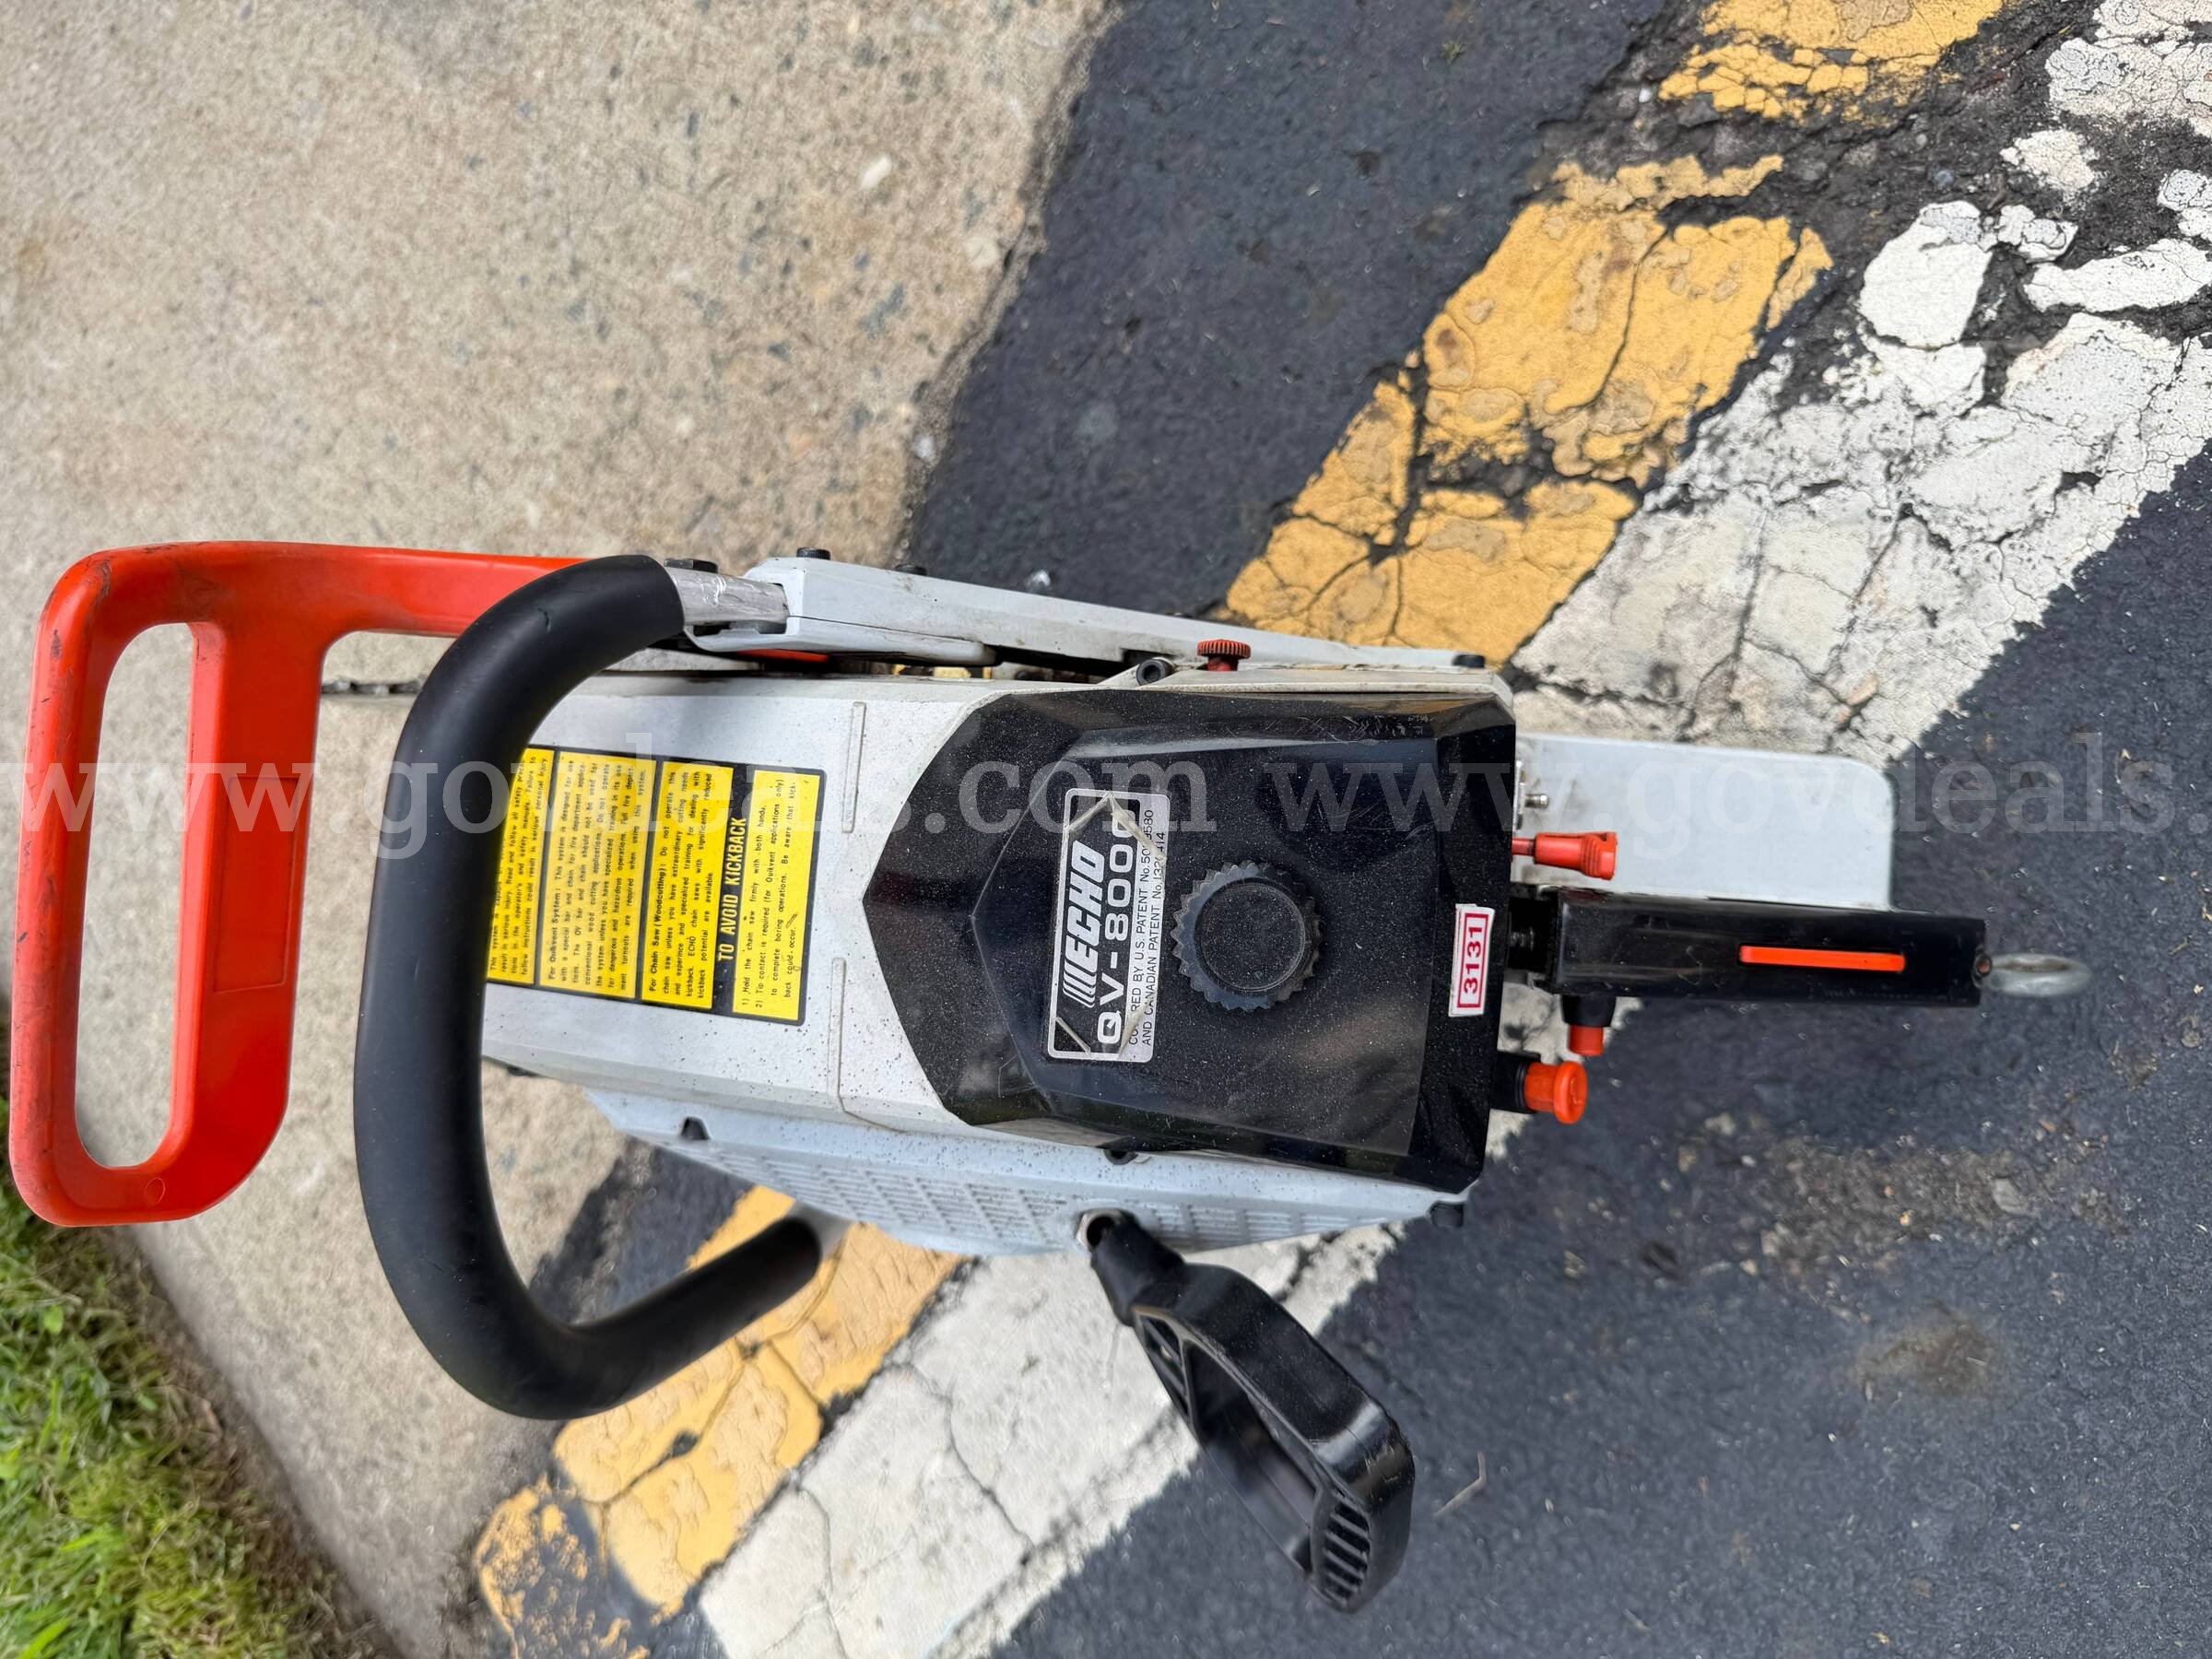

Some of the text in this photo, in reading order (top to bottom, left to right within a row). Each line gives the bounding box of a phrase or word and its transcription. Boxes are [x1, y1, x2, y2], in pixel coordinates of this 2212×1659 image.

[679, 771, 688, 791] needs
[701, 773, 712, 799] reduced
[773, 779, 784, 796] only)
[787, 782, 795, 798] kick-
[664, 792, 676, 818] operate
[676, 798, 687, 822] cutting
[688, 794, 700, 818] dealing
[697, 808, 710, 850] significantly
[769, 803, 782, 844] applications
[754, 834, 762, 851] both
[783, 826, 792, 848] aware
[670, 830, 684, 877] extraordinary
[683, 842, 694, 869] training
[765, 851, 777, 882] Quikvent
[679, 877, 691, 915] specialized
[703, 871, 713, 902] available.
[718, 817, 745, 962] TO AVOID KICKBACK
[749, 882, 759, 902] firmly
[776, 872, 789, 912] operations.
[689, 909, 698, 927] chain
[1065, 841, 1105, 973] ECHO
[1135, 894, 1147, 937] PATENT
[759, 907, 771, 935] required
[773, 918, 784, 942] boring
[1097, 810, 1136, 1044] QV-8000
[1148, 905, 1160, 951] PATENT
[652, 928, 660, 946] Saw
[665, 926, 673, 948] unless
[687, 935, 696, 957] ECHO
[699, 929, 711, 960] potential
[745, 931, 754, 950] chain
[1134, 939, 1145, 960] U.S.
[649, 950, 658, 973] Chain
[757, 951, 766, 979] contact
[771, 948, 782, 981] complete
[784, 954, 794, 974] could
[1464, 927, 1482, 994] 3131
[685, 965, 693, 996] kickback.
[697, 969, 705, 998] kickback
[741, 976, 749, 993] Hold
[1133, 972, 1142, 983] BY
[1144, 957, 1156, 1016] CANADIAN
[1128, 988, 1141, 1045] CORED
[1142, 1020, 1152, 1046] AND
